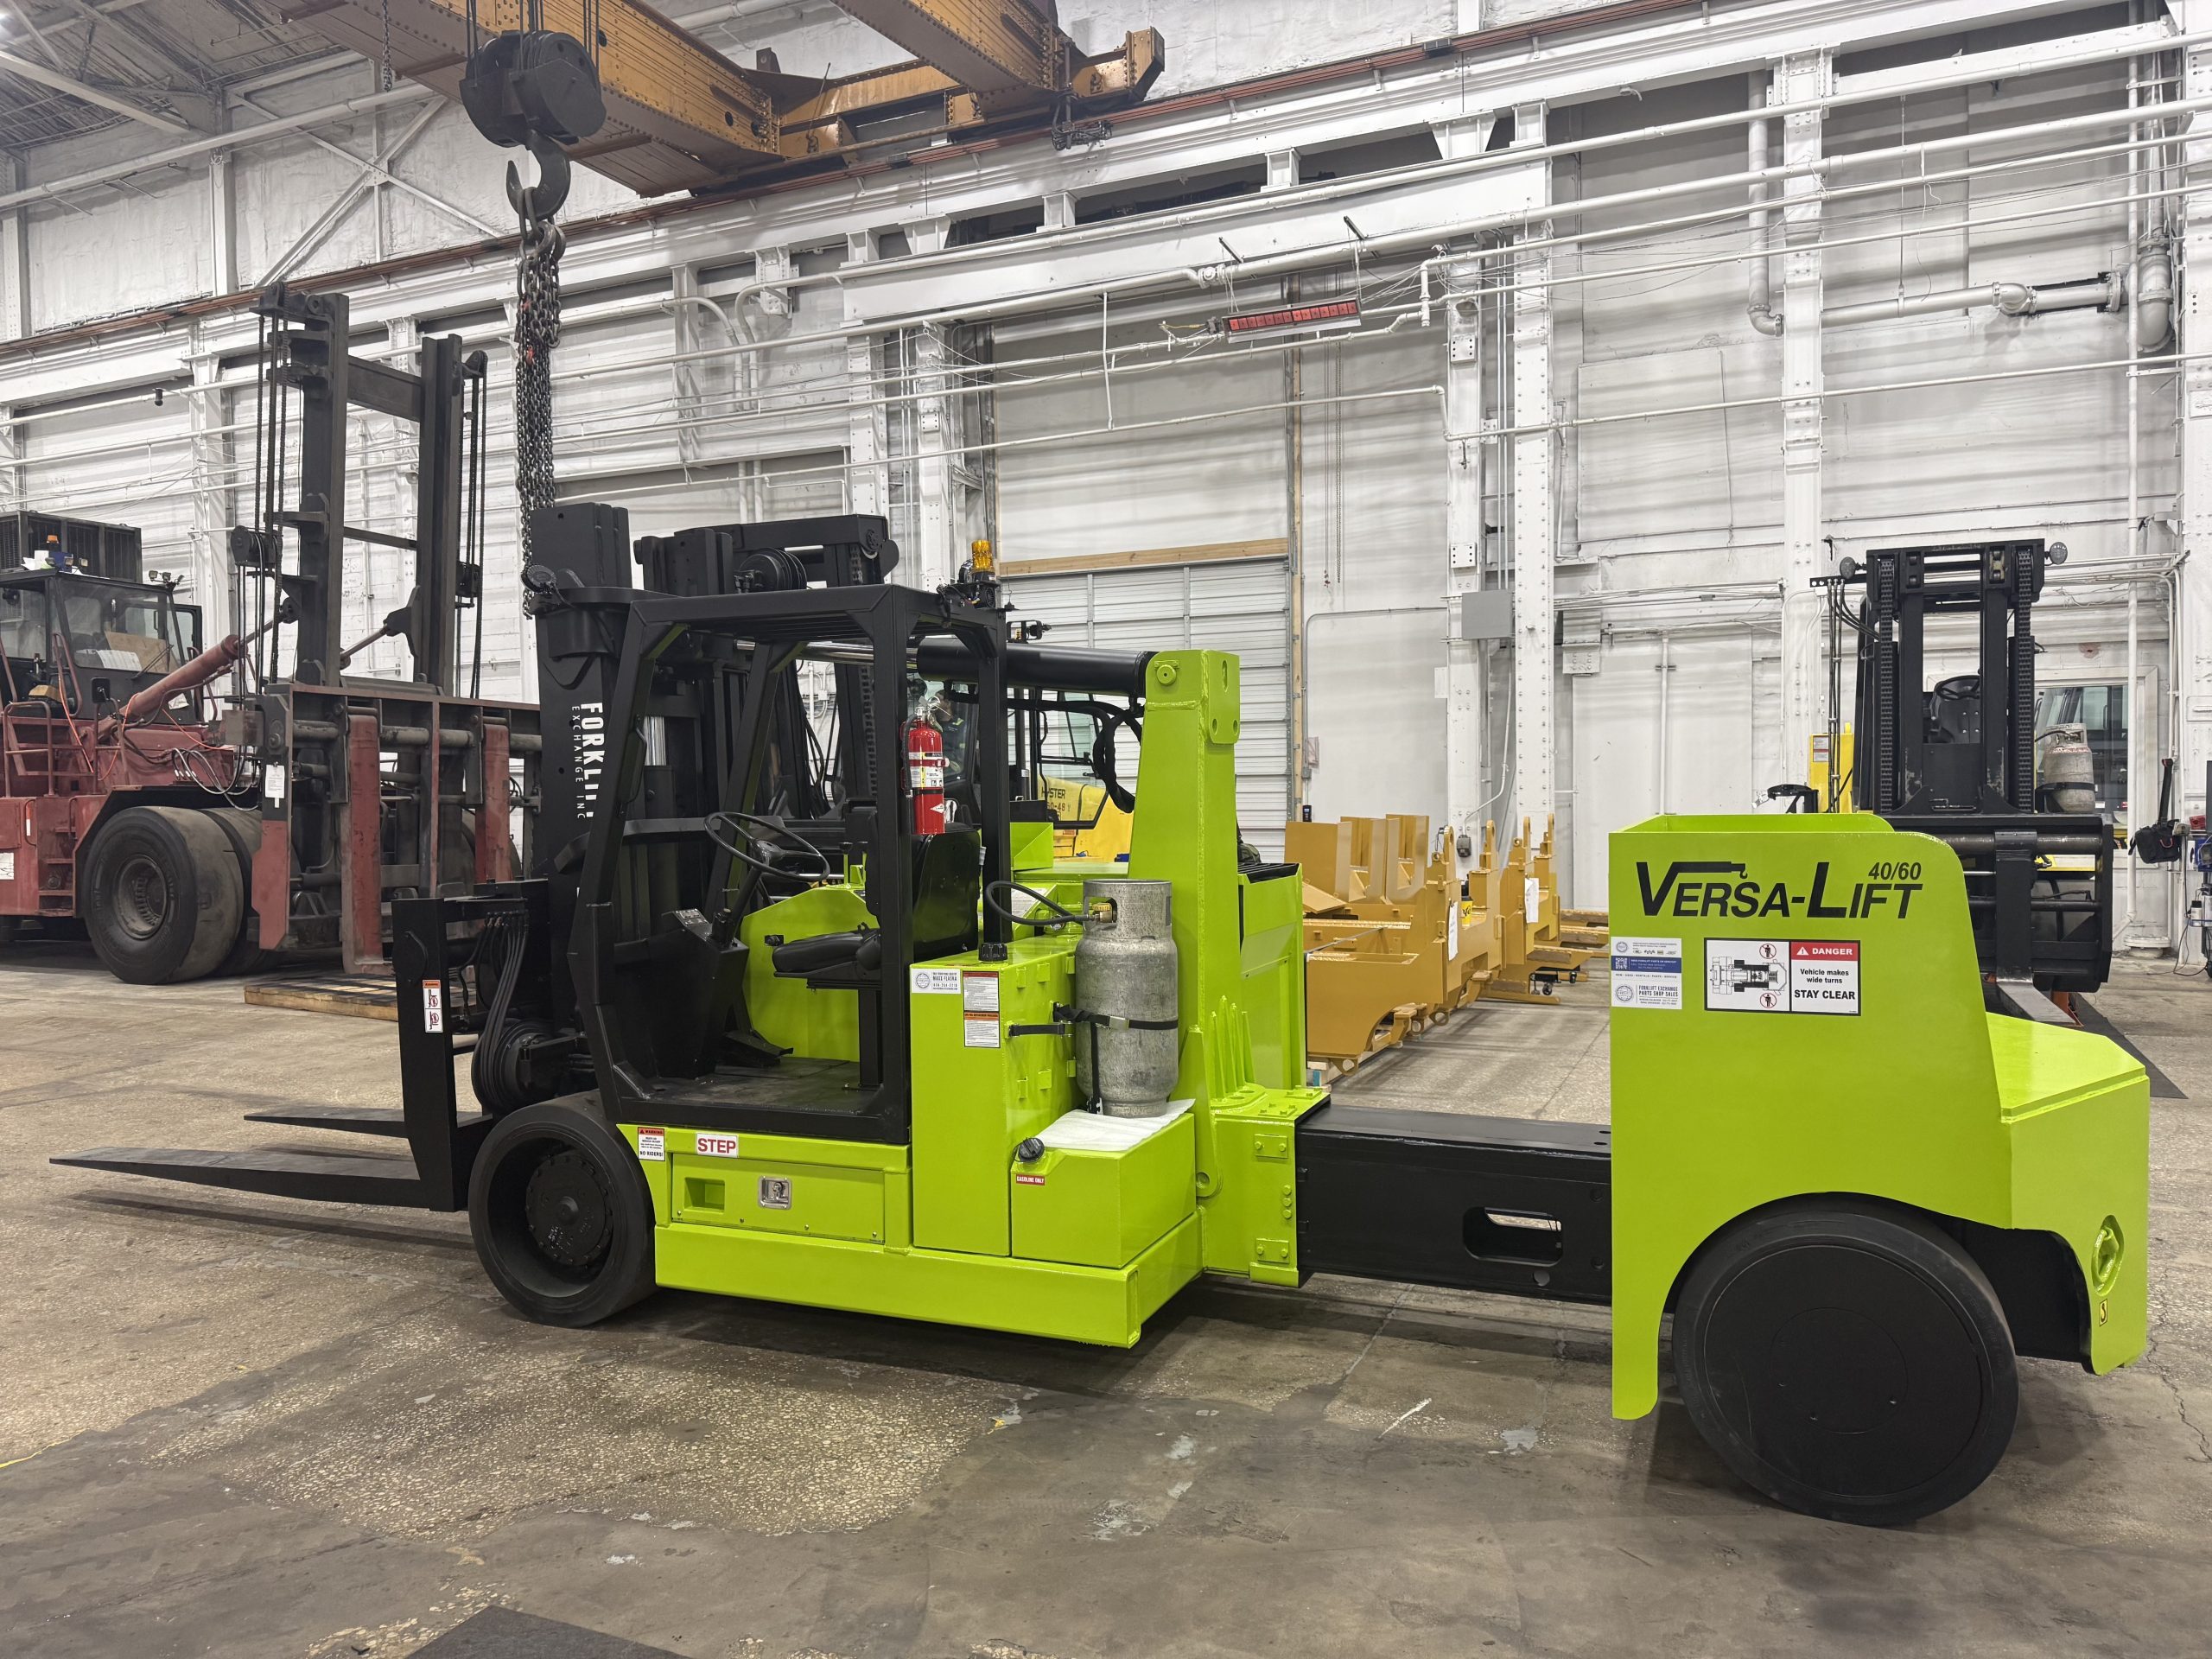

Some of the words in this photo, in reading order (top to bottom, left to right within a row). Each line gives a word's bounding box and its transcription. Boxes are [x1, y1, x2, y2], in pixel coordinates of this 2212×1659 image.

[571, 705, 584, 783] EXCHANGE
[581, 702, 605, 817] FORKLI
[576, 795, 586, 819] INC
[1868, 861, 1922, 880] 40/60
[1636, 861, 1923, 919] VERSA-LIFT
[1812, 947, 1853, 956] DANGER
[1800, 968, 1825, 976] Vehicle
[1806, 976, 1823, 984] wide
[1794, 989, 1820, 999] STAY
[1822, 990, 1856, 1000] CLEAR
[697, 1138, 736, 1154] STEP
